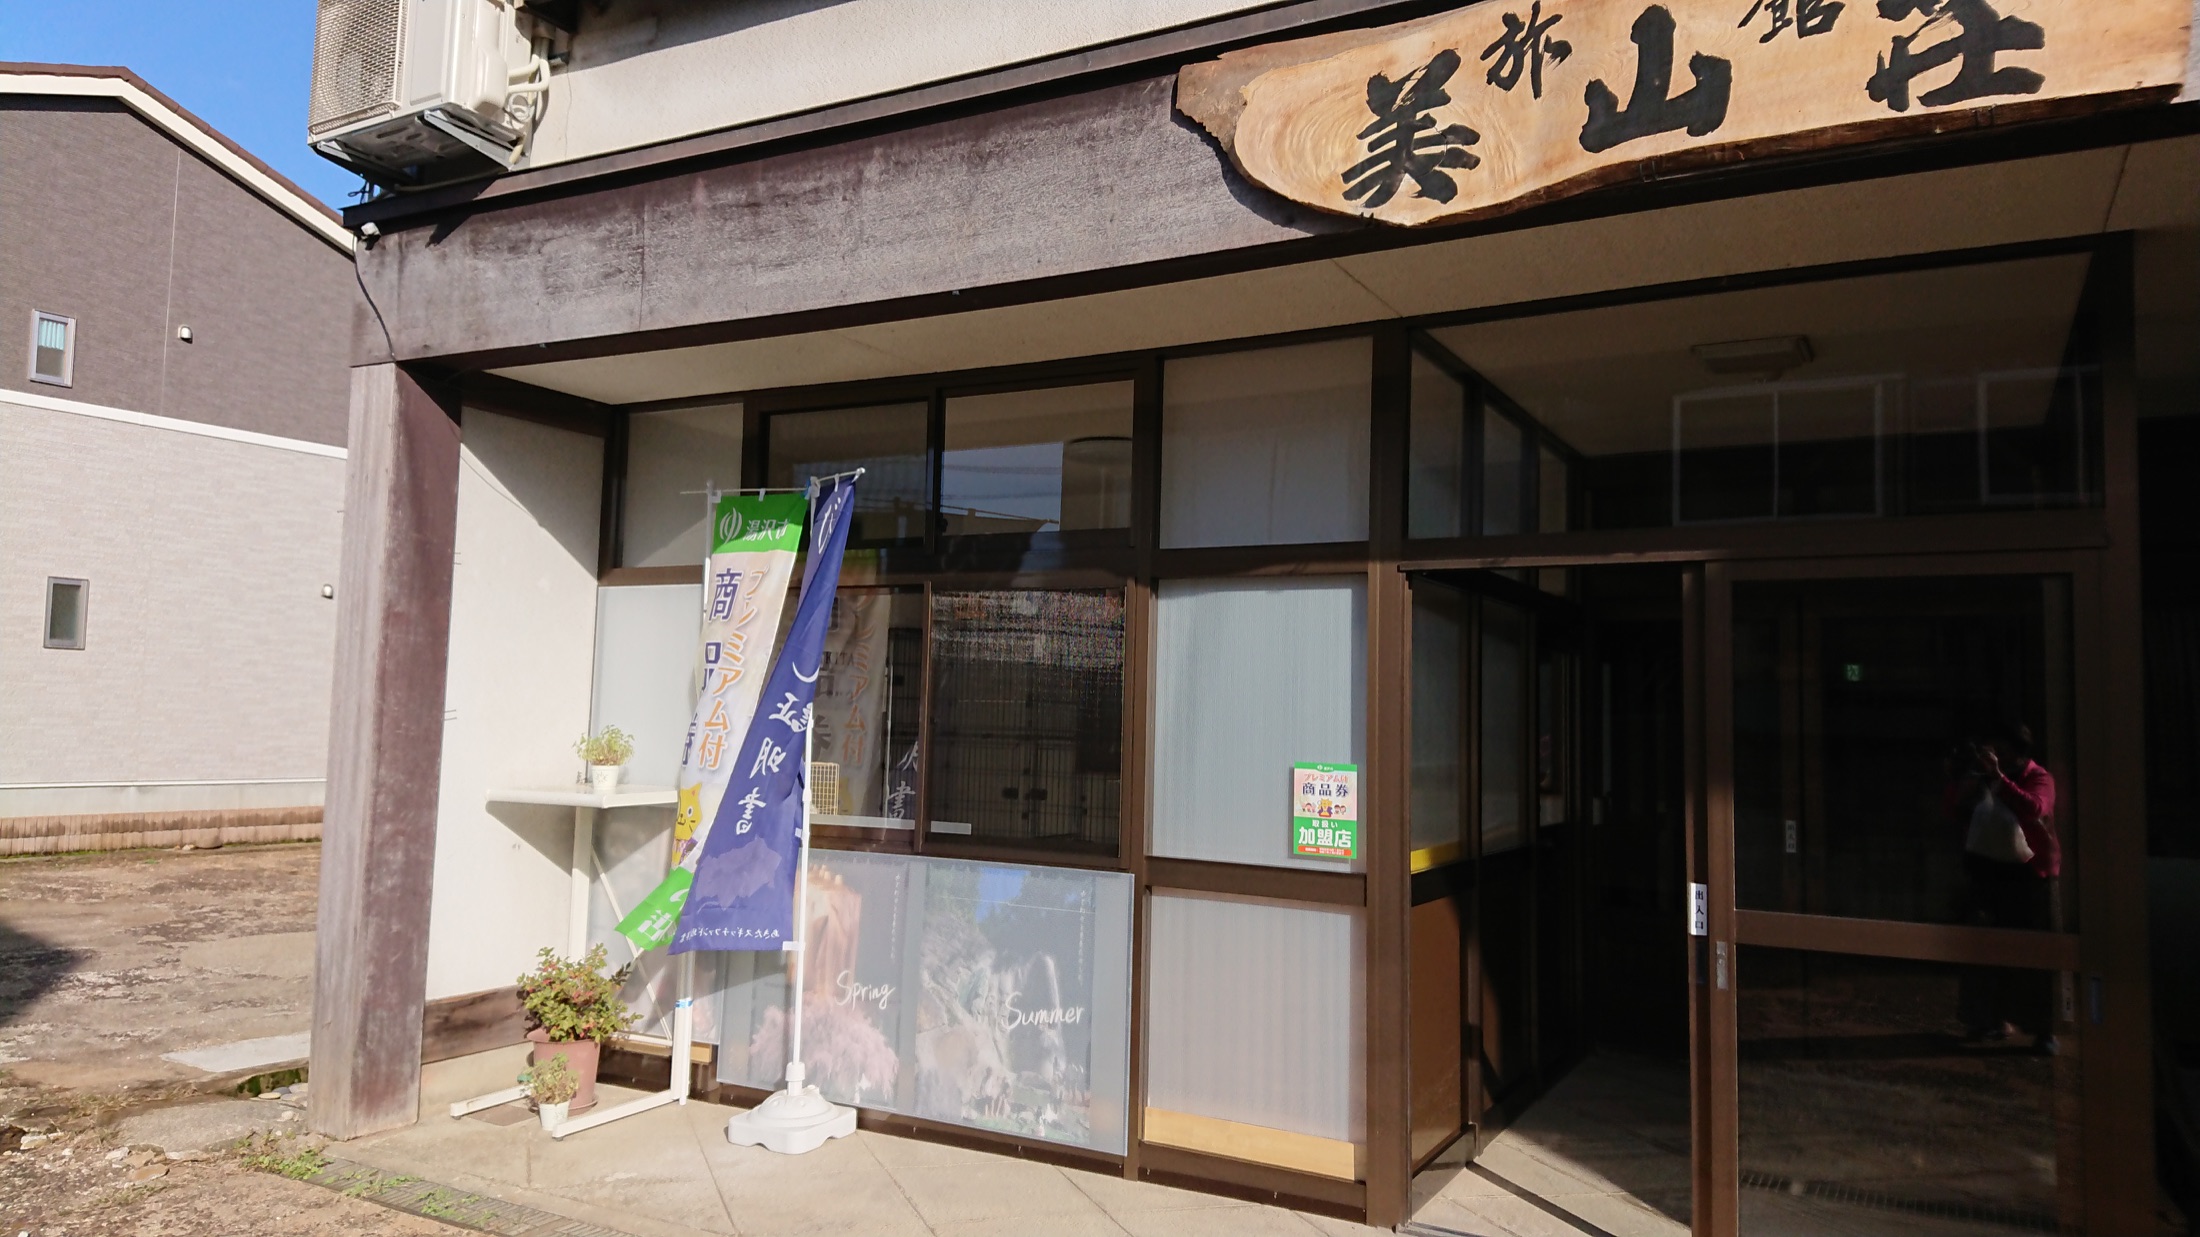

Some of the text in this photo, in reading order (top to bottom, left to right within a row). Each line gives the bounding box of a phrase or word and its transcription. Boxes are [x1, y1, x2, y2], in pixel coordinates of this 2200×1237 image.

[1302, 782, 1348, 798] 商品券
[1298, 827, 1352, 848] 加盟店
[1312, 819, 1338, 828] 取扱い
[1695, 890, 1704, 930] 出入口
[836, 969, 896, 1011] Spring
[1002, 991, 1085, 1029] Summer
